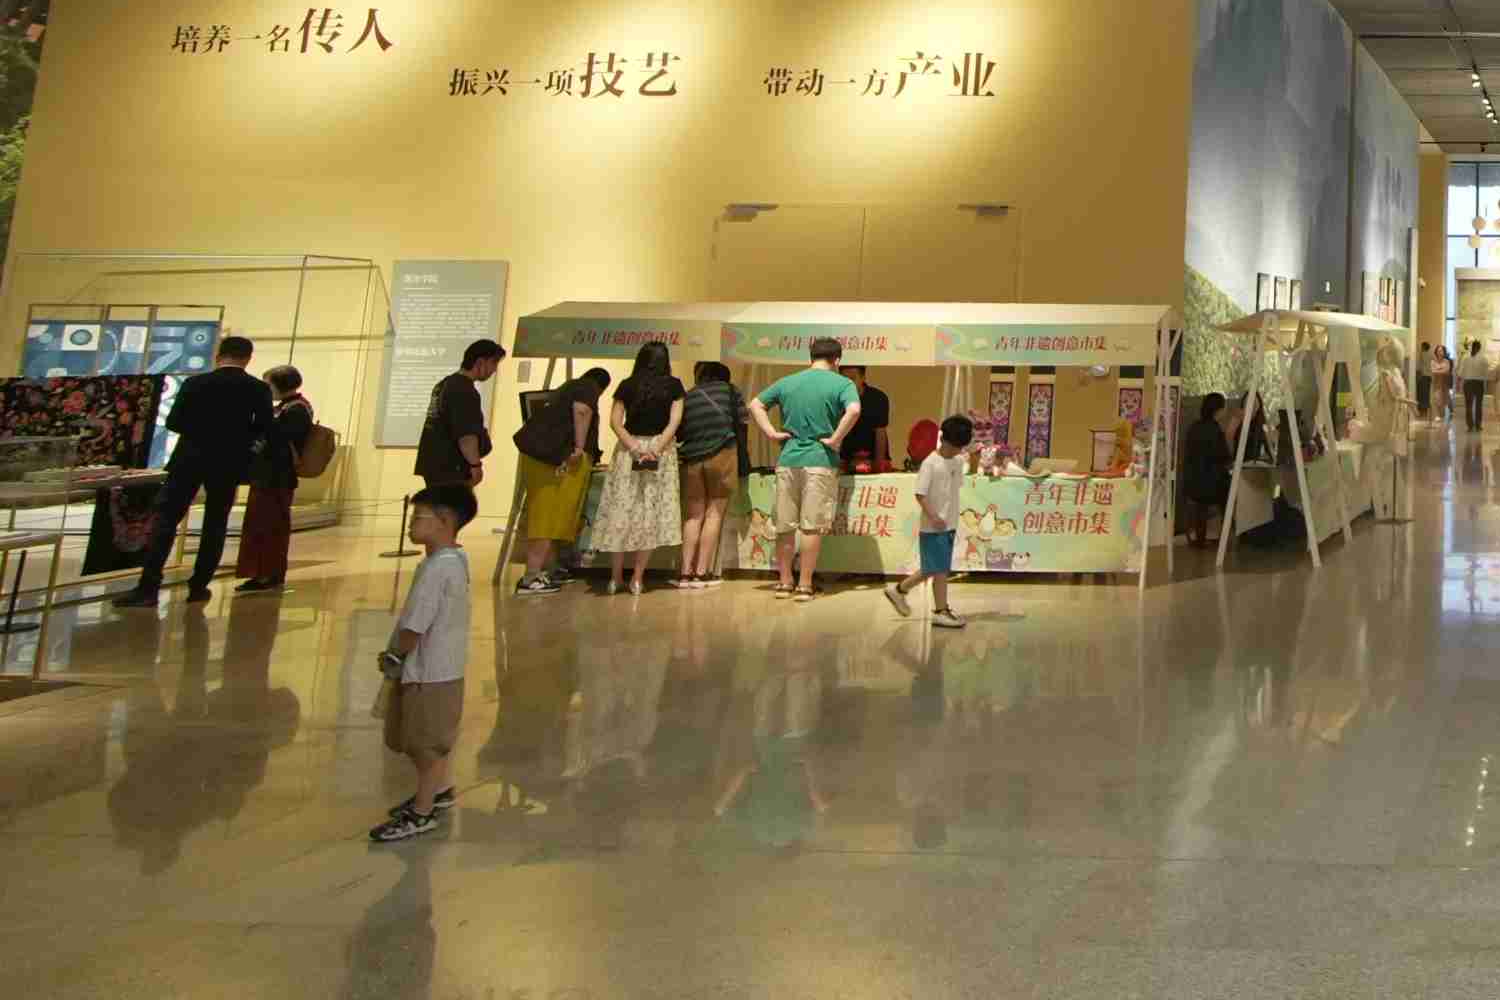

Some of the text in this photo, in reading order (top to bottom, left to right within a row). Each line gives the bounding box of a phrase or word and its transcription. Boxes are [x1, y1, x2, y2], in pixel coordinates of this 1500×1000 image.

[171, 8, 393, 53] 培养一名传人
[449, 52, 681, 99] 振兴一项技艺
[763, 51, 997, 98] 带动一方产业
[778, 335, 888, 351] 青年创意市集
[993, 335, 1107, 352] 青年非遗创意市集
[836, 486, 897, 509] 年非遗
[1024, 482, 1113, 506] 青年非遗
[818, 513, 897, 537] 意市集
[1023, 511, 1111, 535] 创意市集
